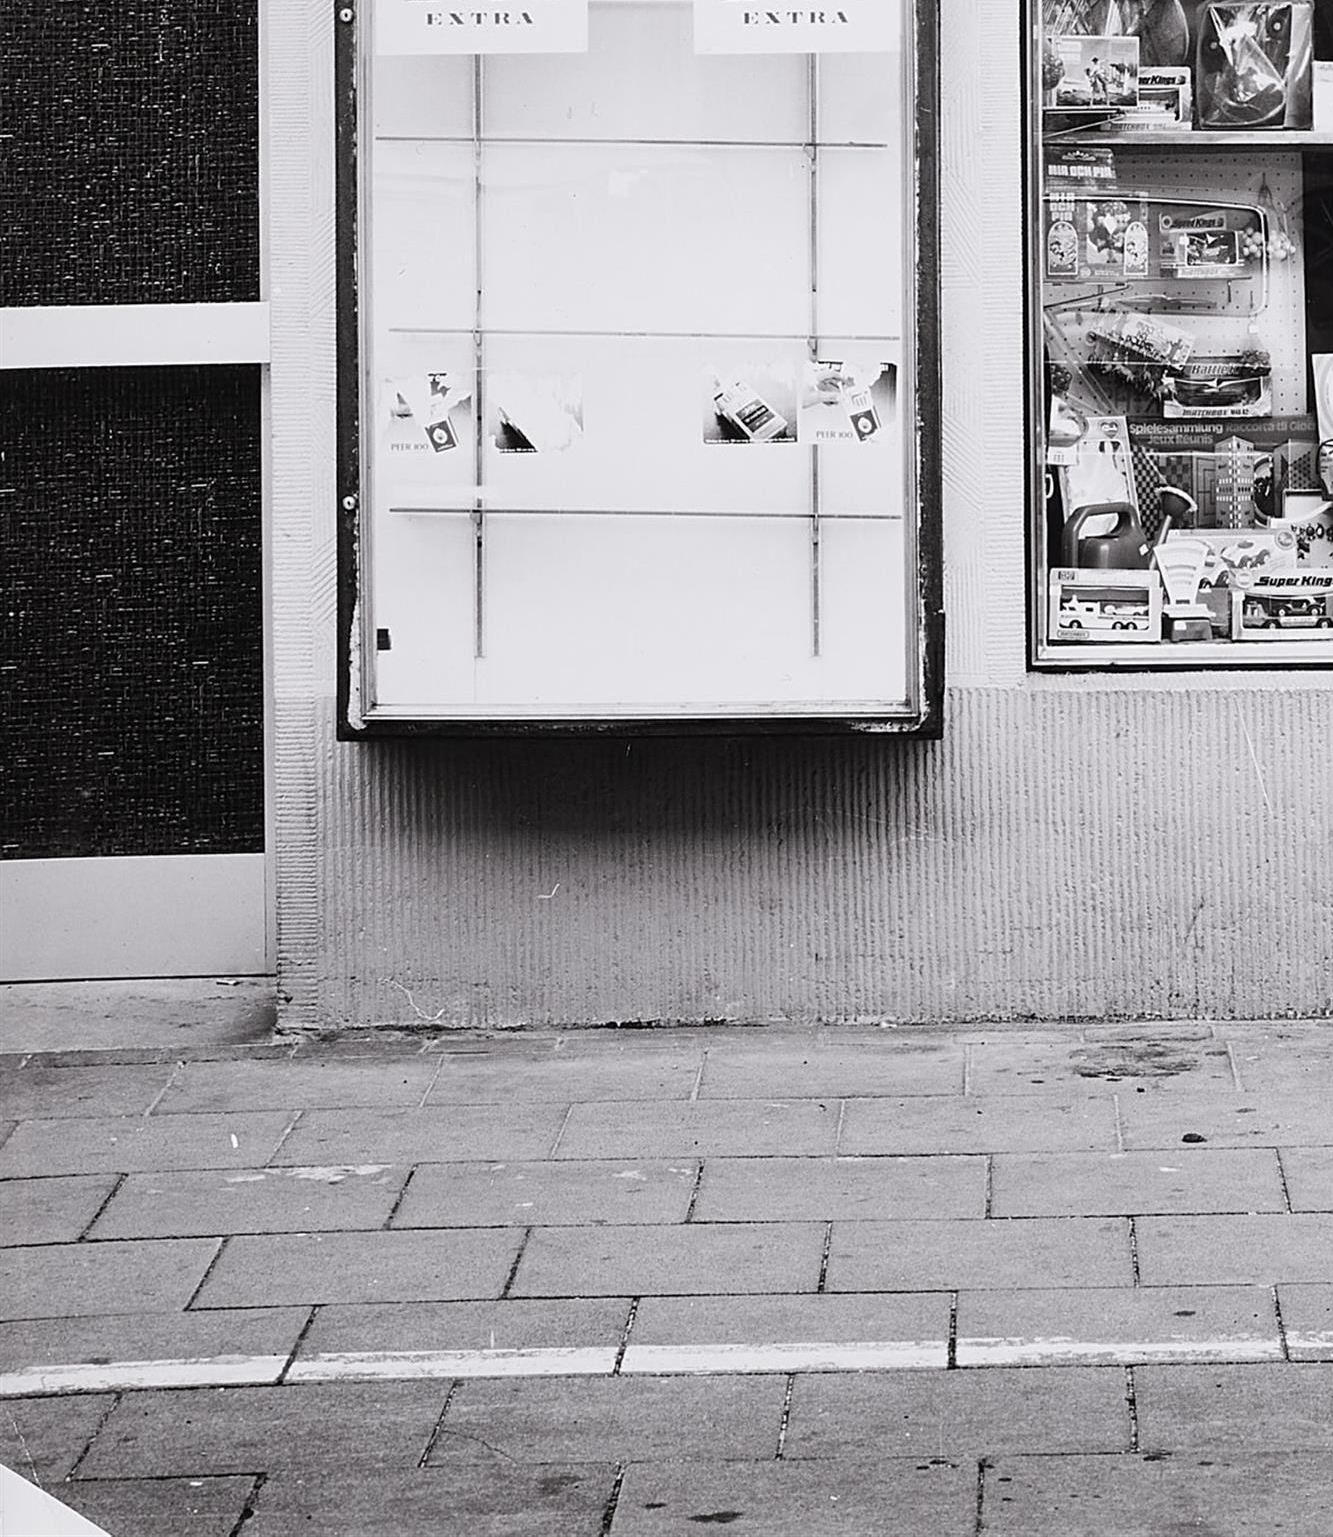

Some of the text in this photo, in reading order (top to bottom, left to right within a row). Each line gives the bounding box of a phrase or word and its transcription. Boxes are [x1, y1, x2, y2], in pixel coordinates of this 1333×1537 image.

[427, 13, 533, 25] EXTRA
[743, 12, 849, 25] EXTRA
[1130, 422, 1223, 435] Spielesammlung
[1148, 434, 1174, 445] Jeux
[1254, 575, 1300, 588] Super
